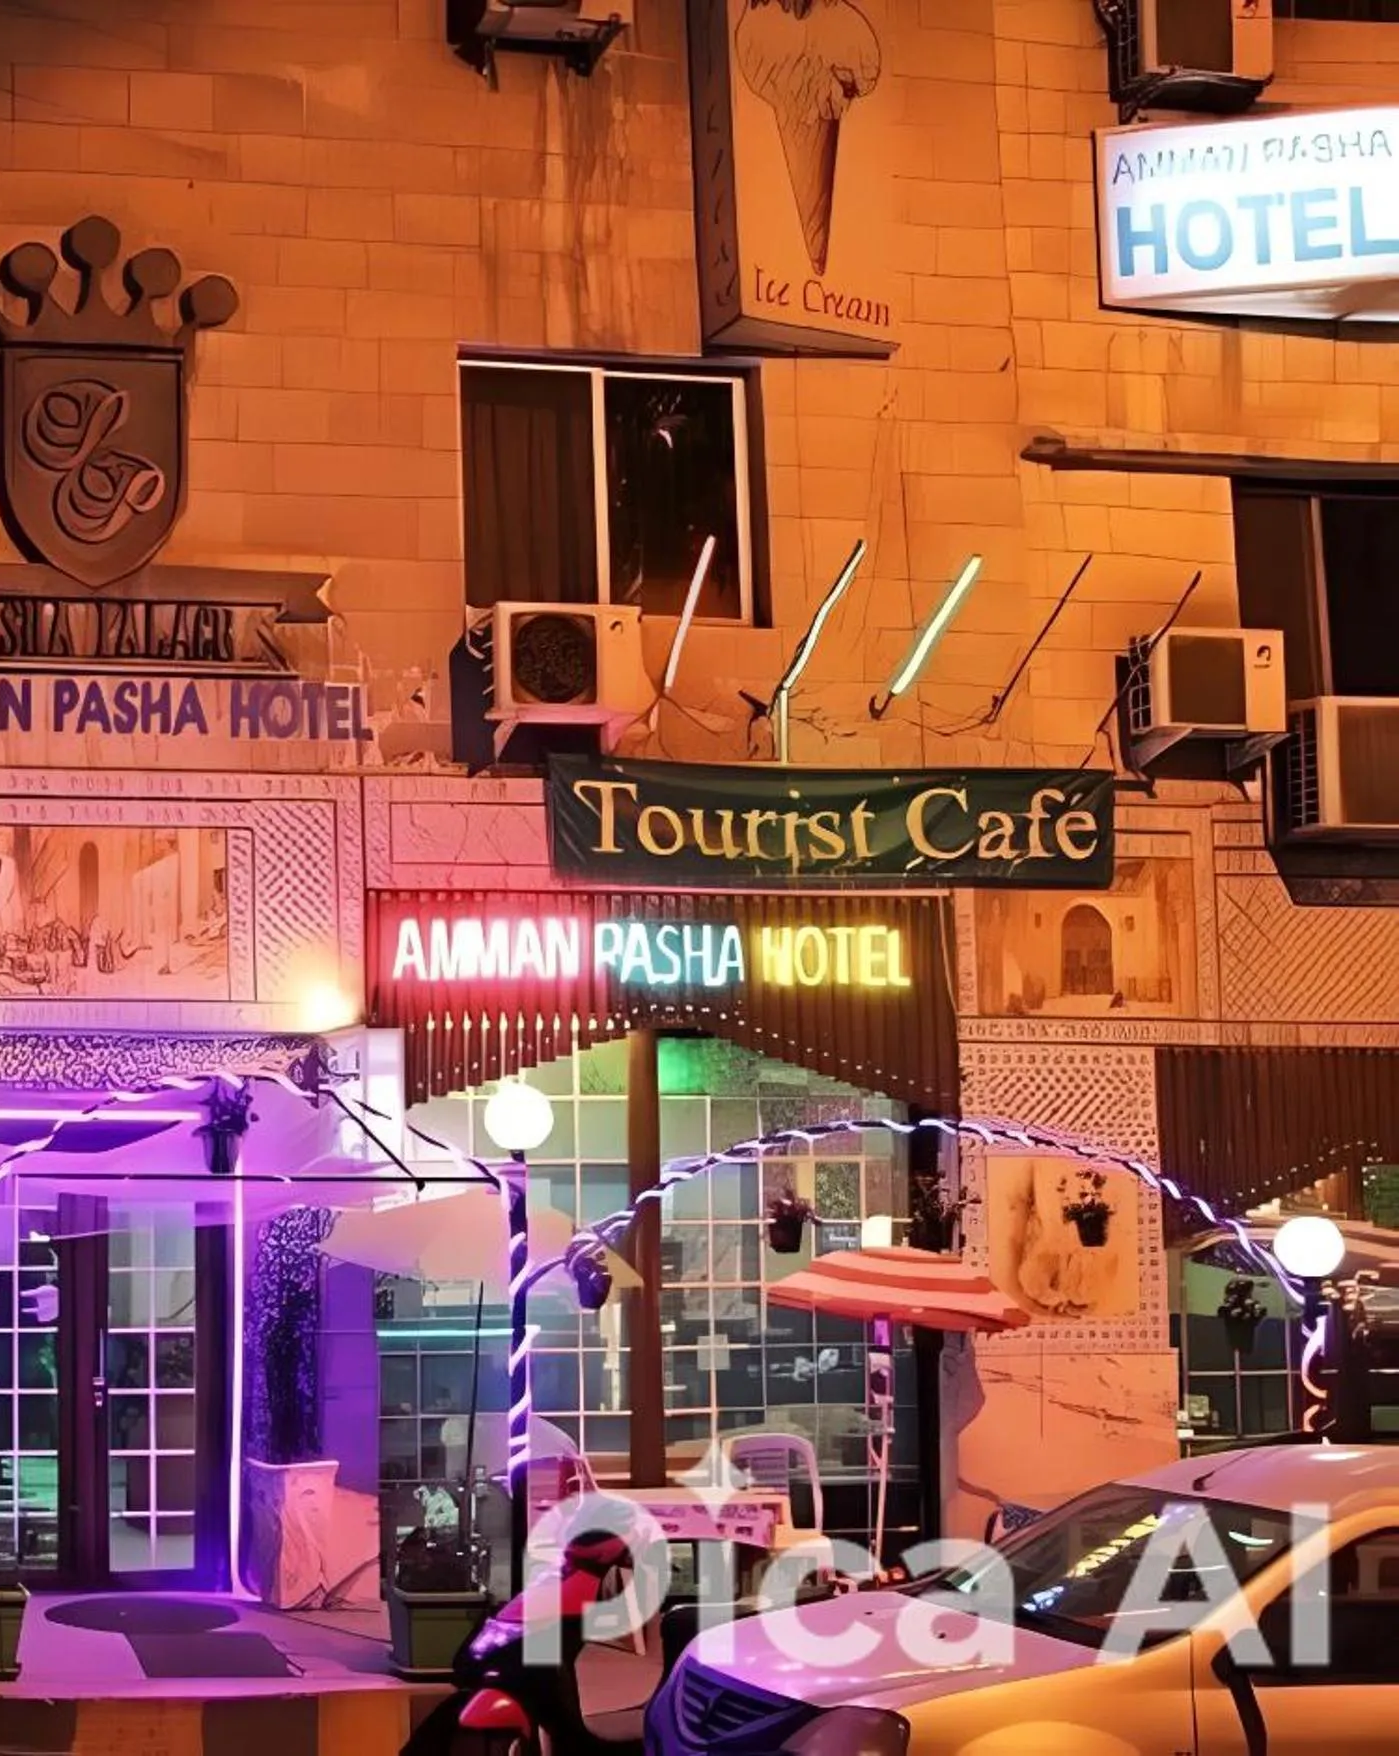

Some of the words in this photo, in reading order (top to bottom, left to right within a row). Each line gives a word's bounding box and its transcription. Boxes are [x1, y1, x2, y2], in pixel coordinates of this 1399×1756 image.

[1116, 185, 1399, 278] HOTEL
[754, 265, 790, 306] Ice
[803, 279, 890, 327] Cream
[53, 678, 209, 736] PASHA
[230, 680, 374, 741] HOTEL
[571, 779, 877, 864] Tourist
[903, 787, 1100, 862] Café
[391, 917, 581, 982] AMMAN
[592, 921, 745, 986] PASHA
[760, 924, 911, 988] HOTEL
